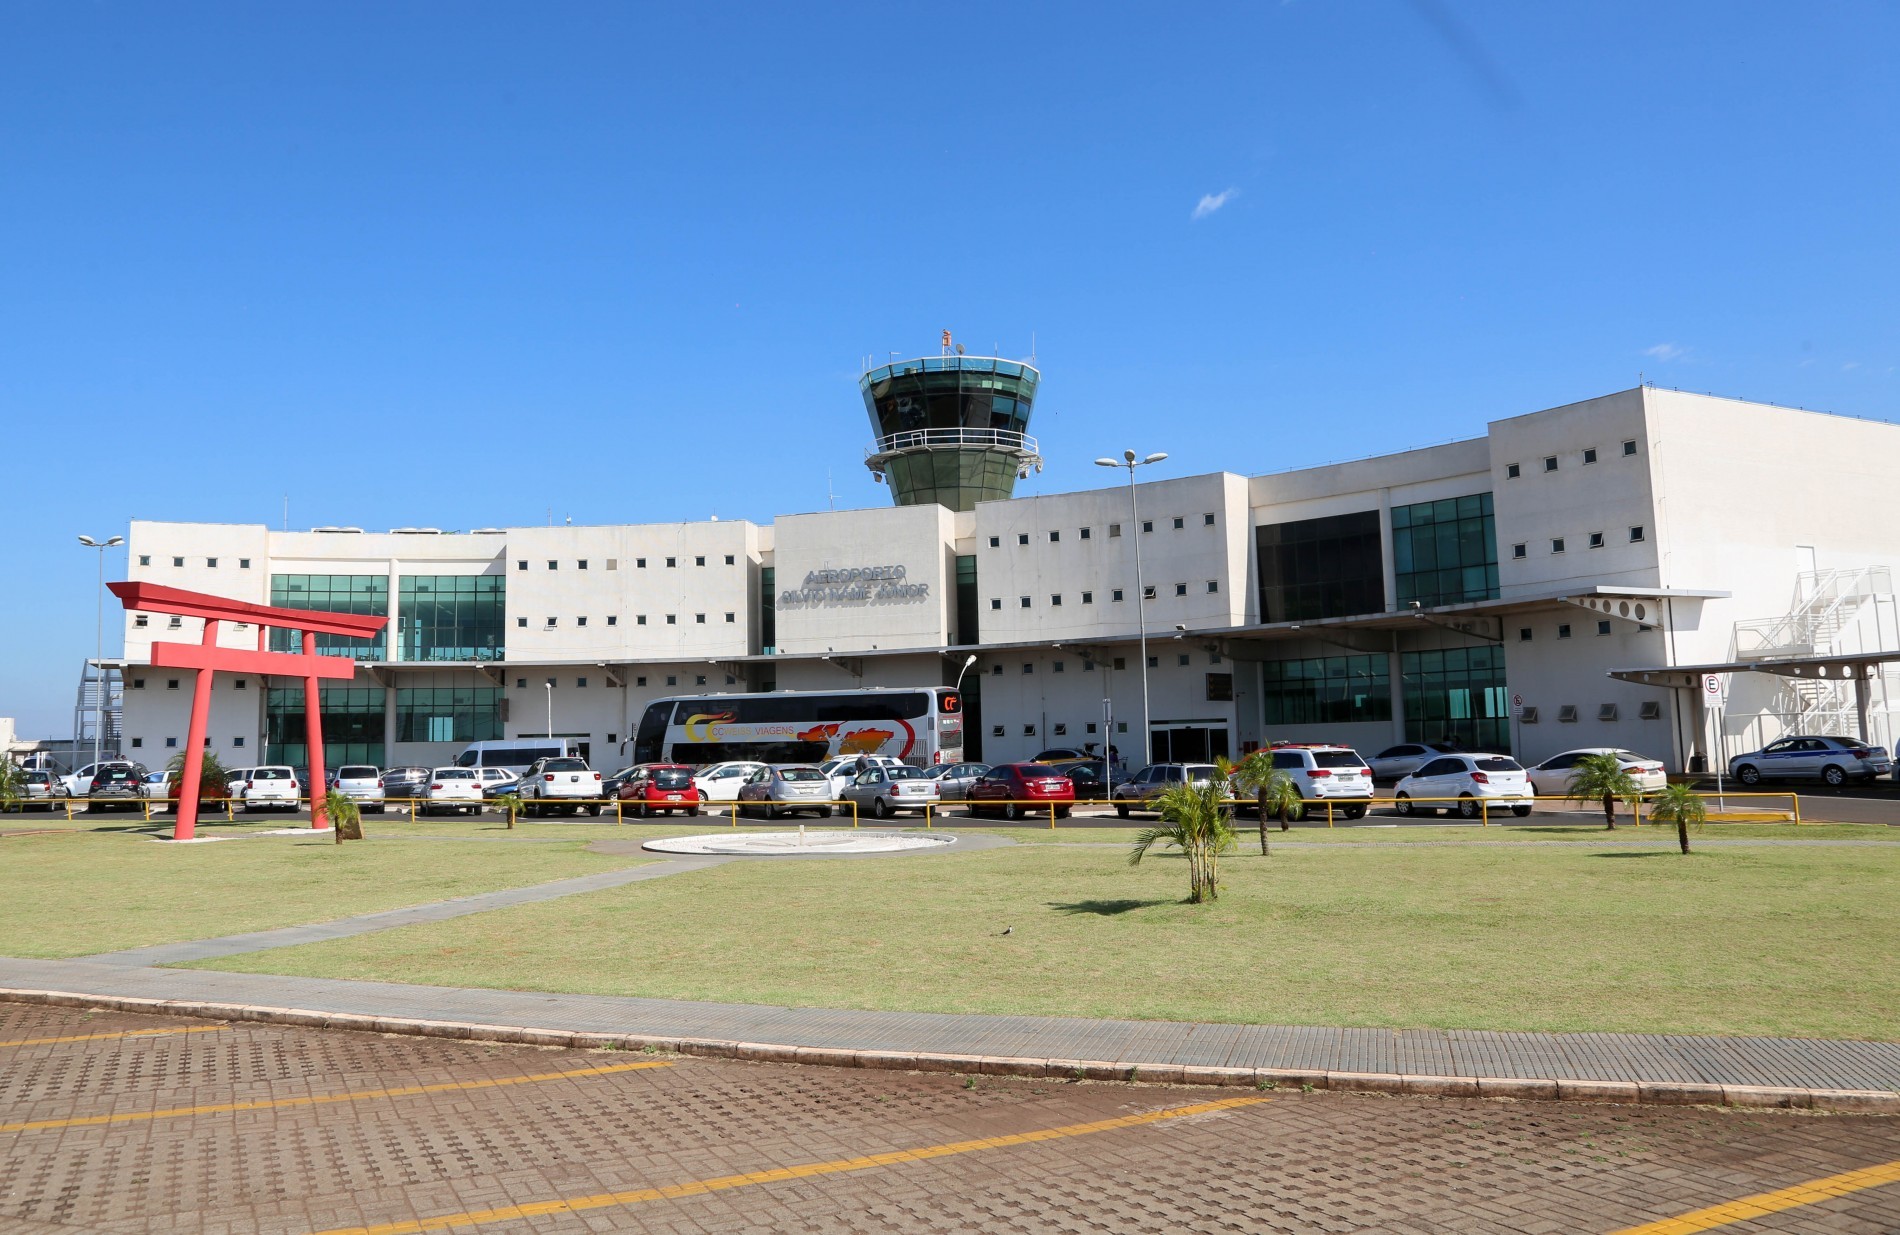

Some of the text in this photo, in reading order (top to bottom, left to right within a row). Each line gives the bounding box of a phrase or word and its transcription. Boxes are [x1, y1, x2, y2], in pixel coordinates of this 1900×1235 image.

[806, 565, 906, 584] AEROPORTO
[1708, 678, 1716, 690] E
[755, 726, 794, 735] VIAGENS
